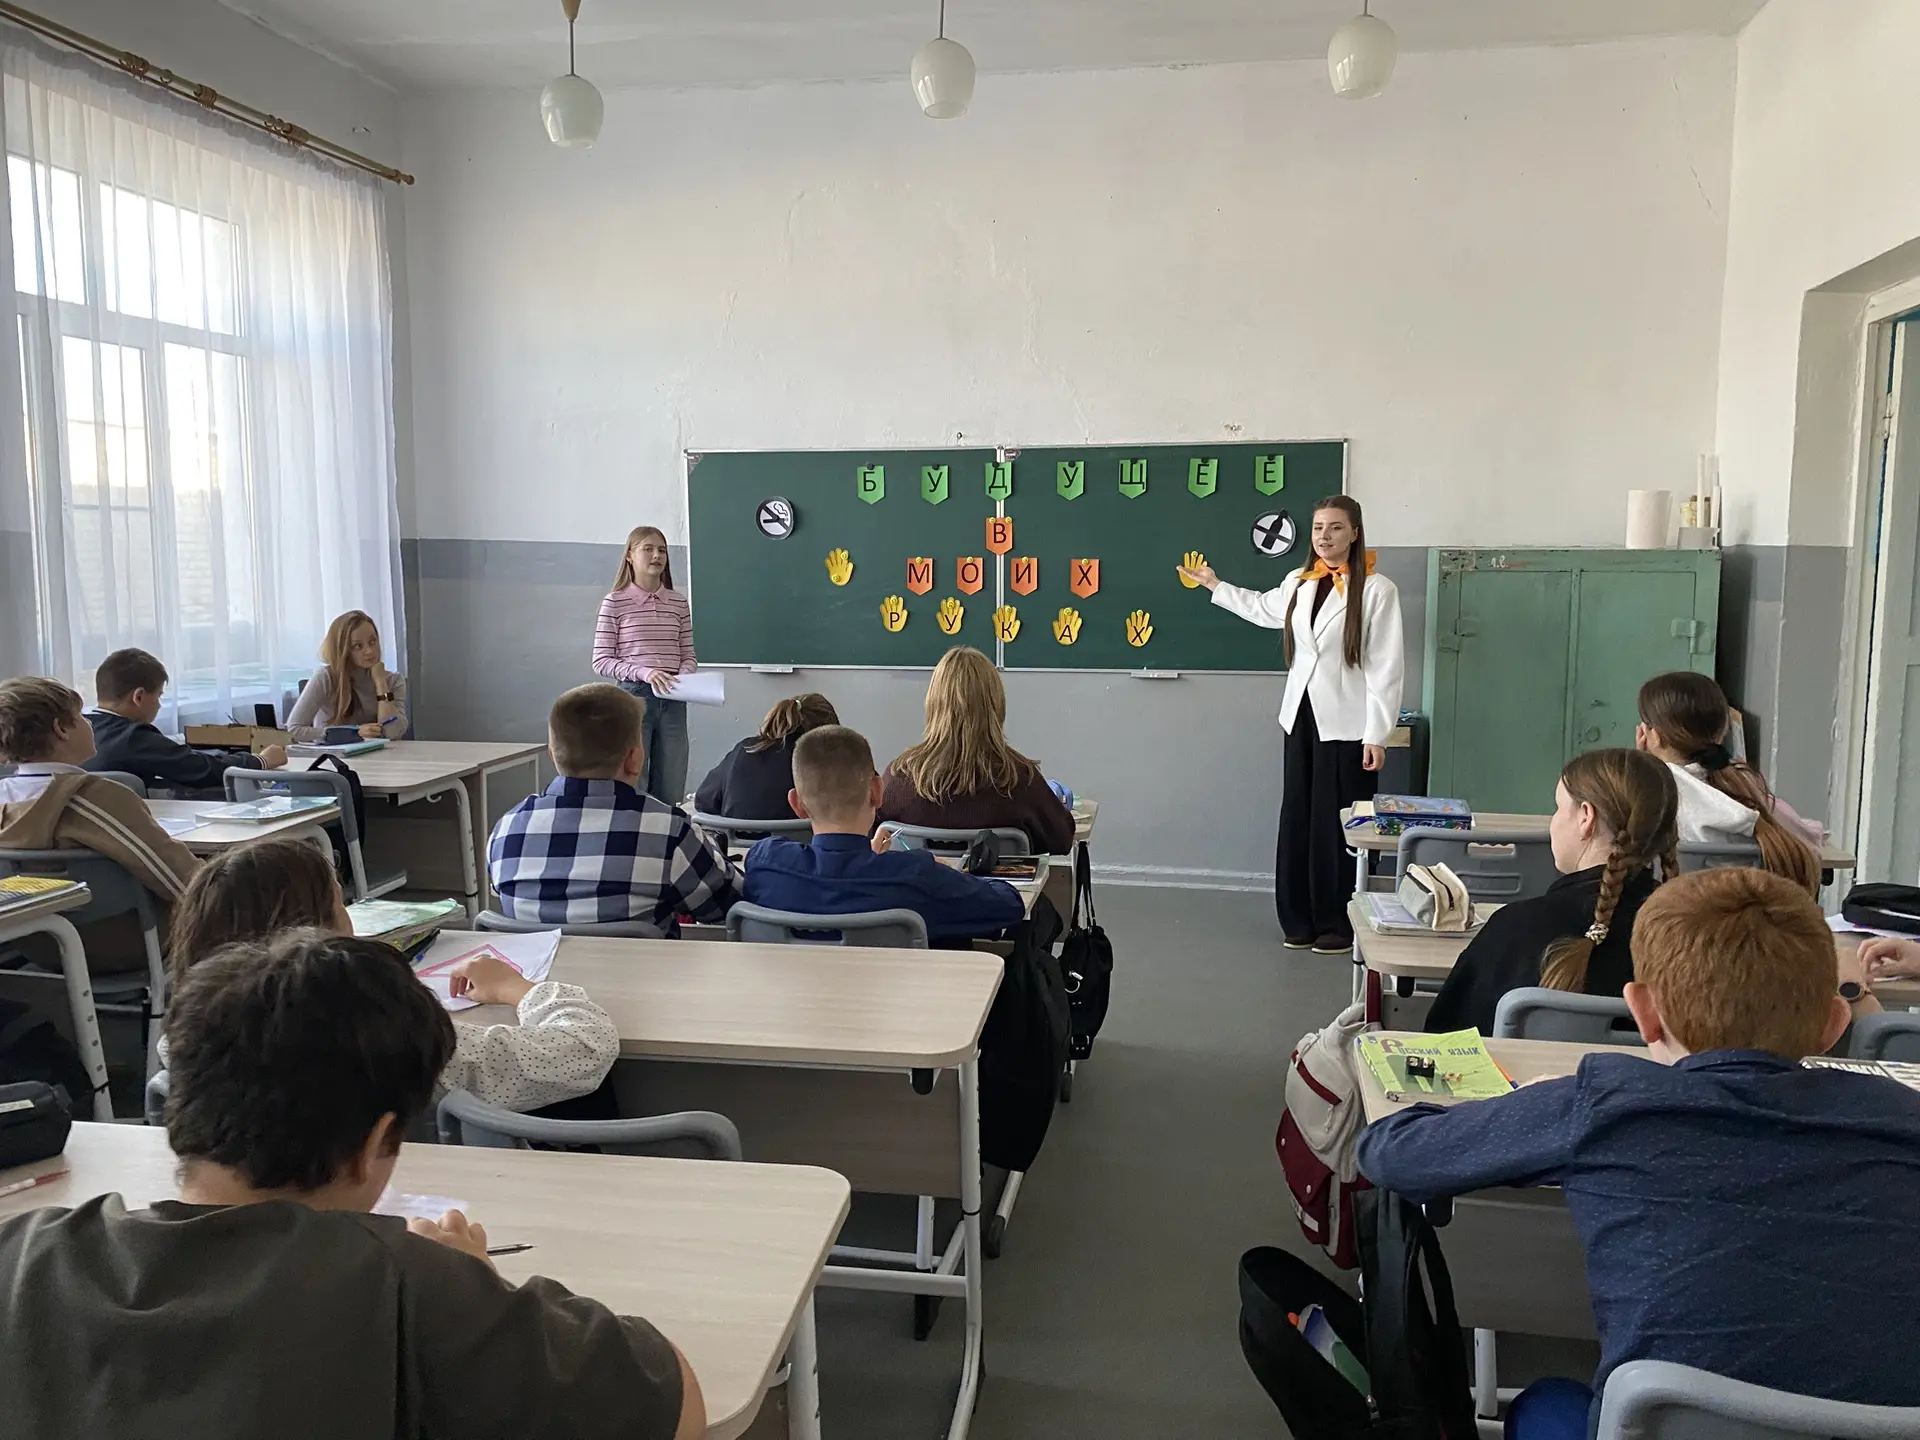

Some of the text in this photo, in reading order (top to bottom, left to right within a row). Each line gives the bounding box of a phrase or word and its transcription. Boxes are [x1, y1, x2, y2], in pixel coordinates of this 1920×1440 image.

[863, 461, 1276, 494] БУДУЩЕЕ
[993, 522, 1007, 544] В
[908, 563, 1093, 587] МОИХ
[889, 611, 1145, 644] РУКАХ
